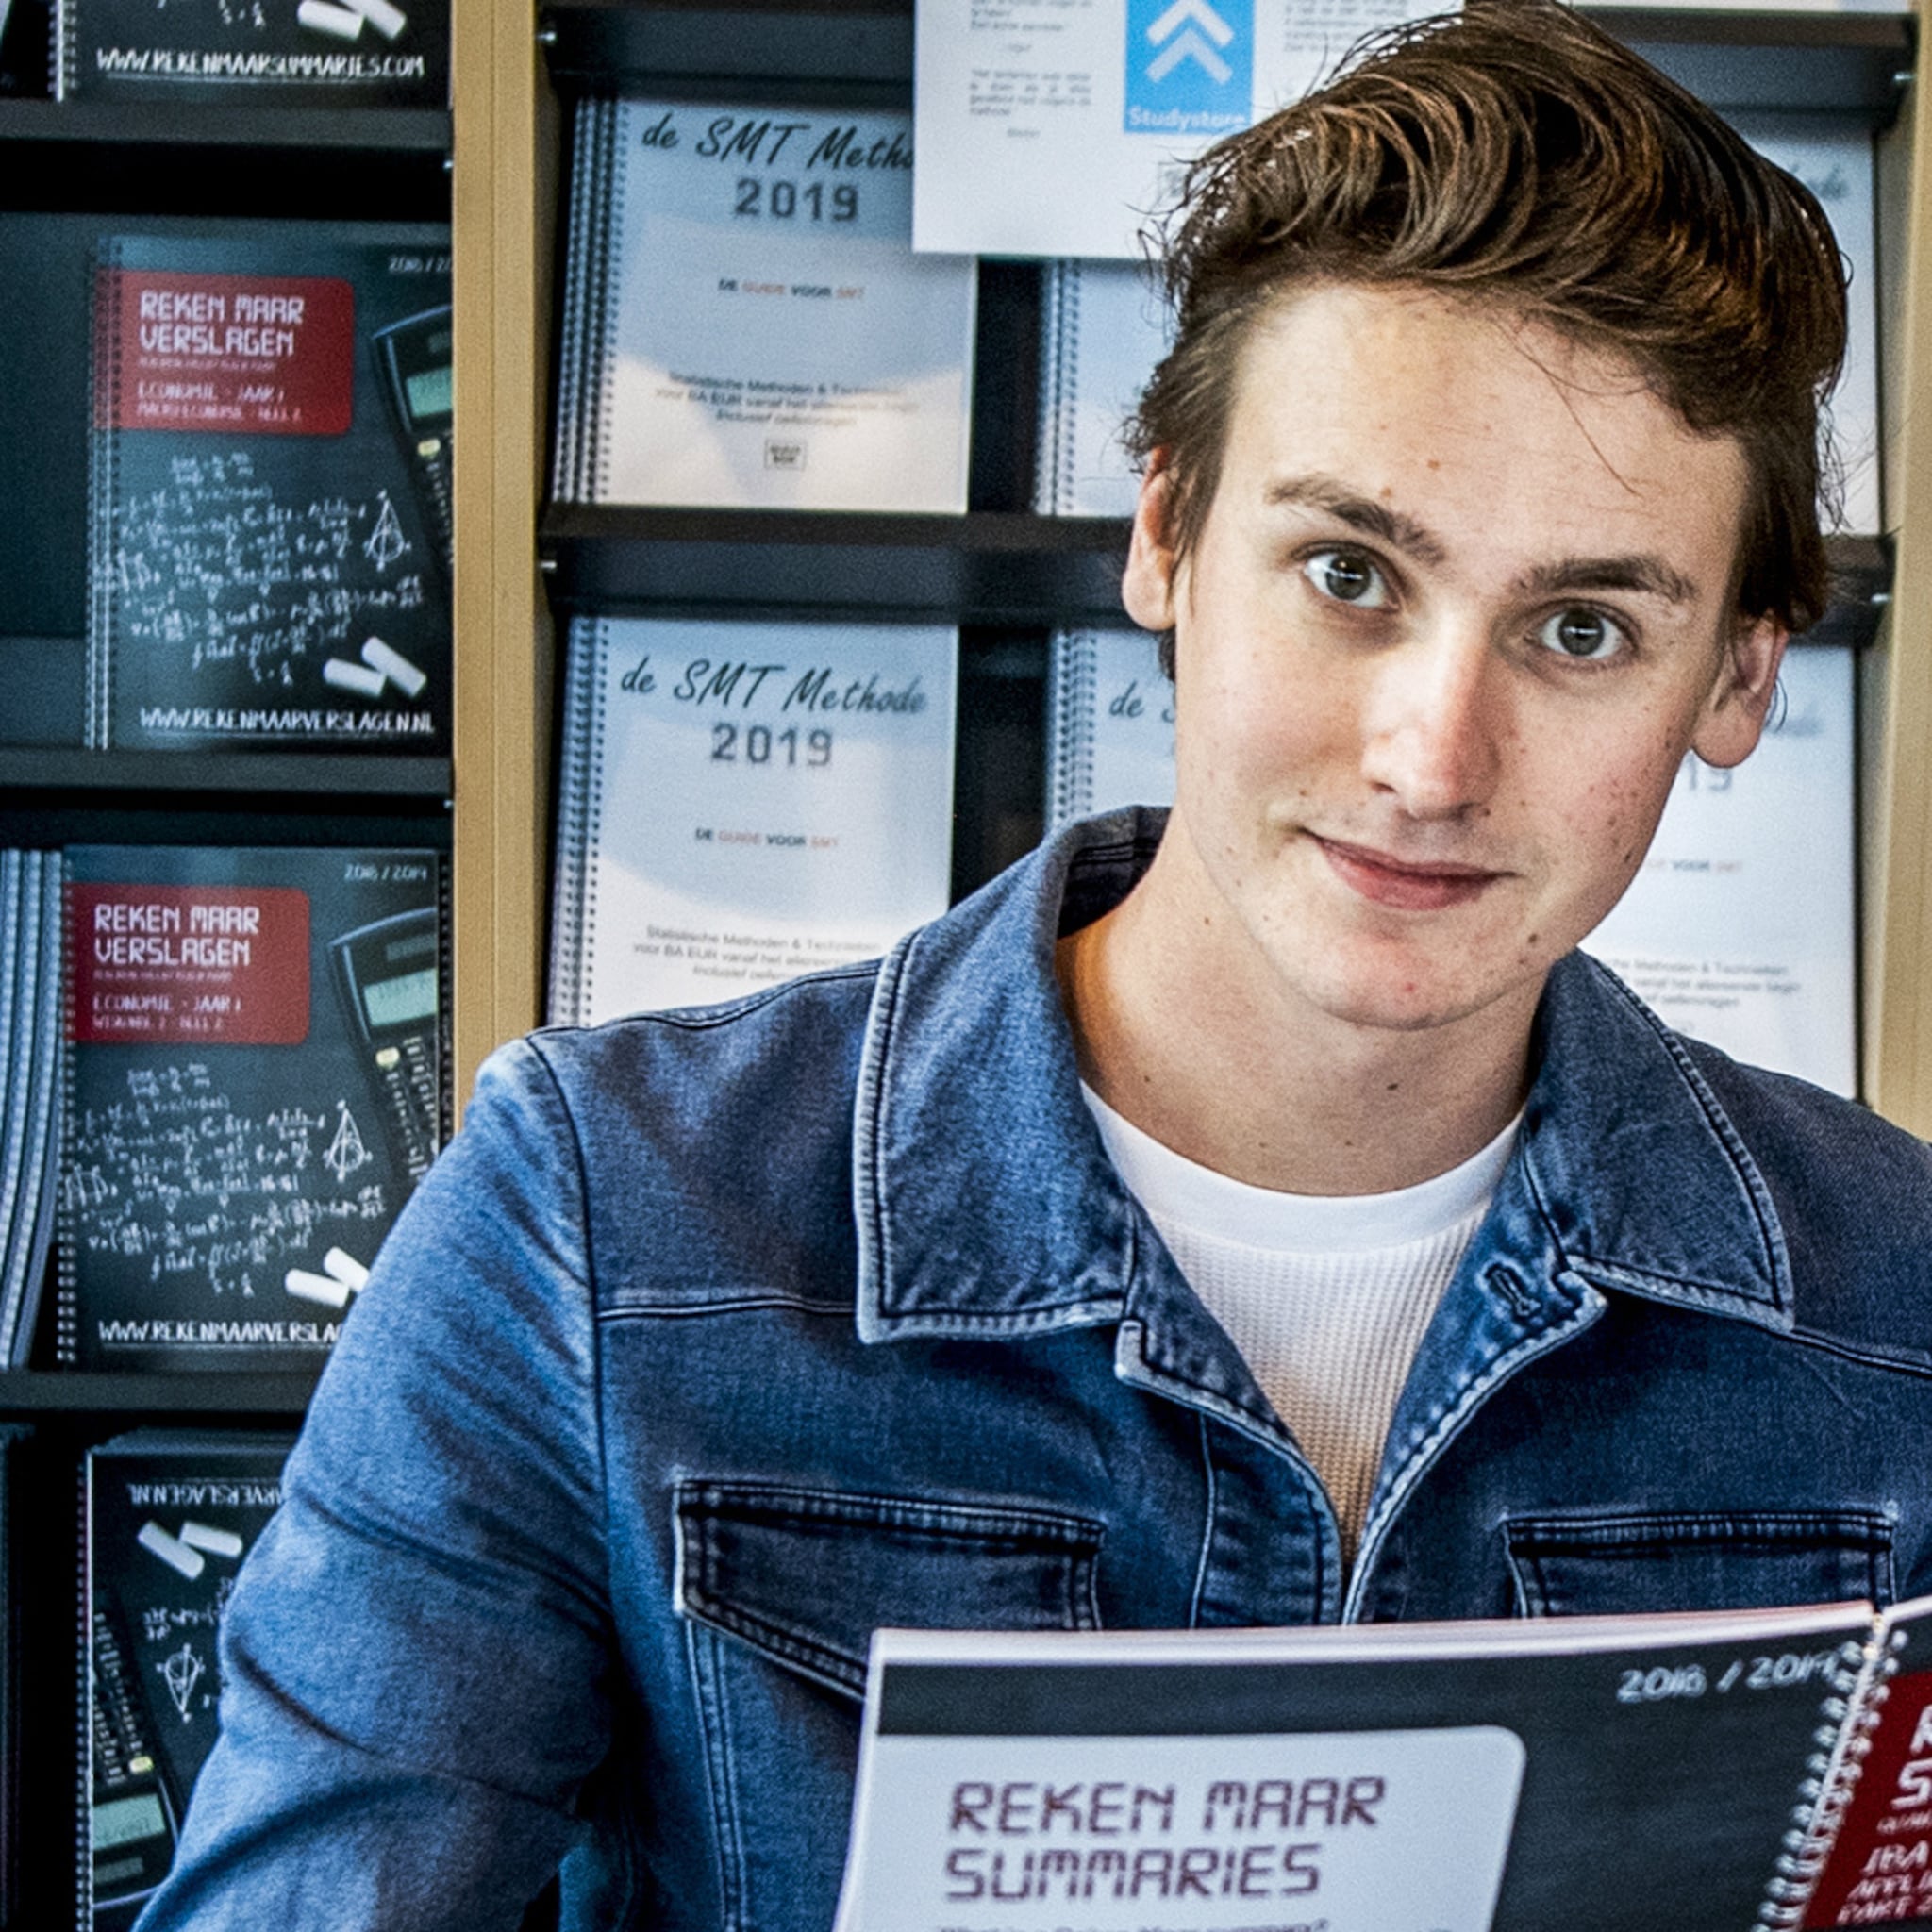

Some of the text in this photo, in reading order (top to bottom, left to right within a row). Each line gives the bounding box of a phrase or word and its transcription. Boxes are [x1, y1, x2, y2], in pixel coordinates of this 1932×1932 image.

[642, 113, 681, 149] de
[696, 117, 810, 164] SMT
[733, 178, 860, 222] 2019
[141, 291, 305, 325] REKEN MAAR
[141, 324, 294, 357] VERSLAGEN
[621, 658, 927, 716] de SMT Methode
[1108, 679, 1145, 719] de
[710, 723, 834, 767] 2019
[766, 834, 806, 846] VOOR
[94, 904, 260, 934] REKEN MAAR
[95, 936, 250, 967] VERSLAGEN
[664, 946, 684, 958] BA
[688, 949, 718, 960] EUR
[1616, 1664, 1707, 1704] 2018
[949, 1775, 1387, 1835] REKEN MAAR
[944, 1841, 1324, 1904] SUMMARIES
